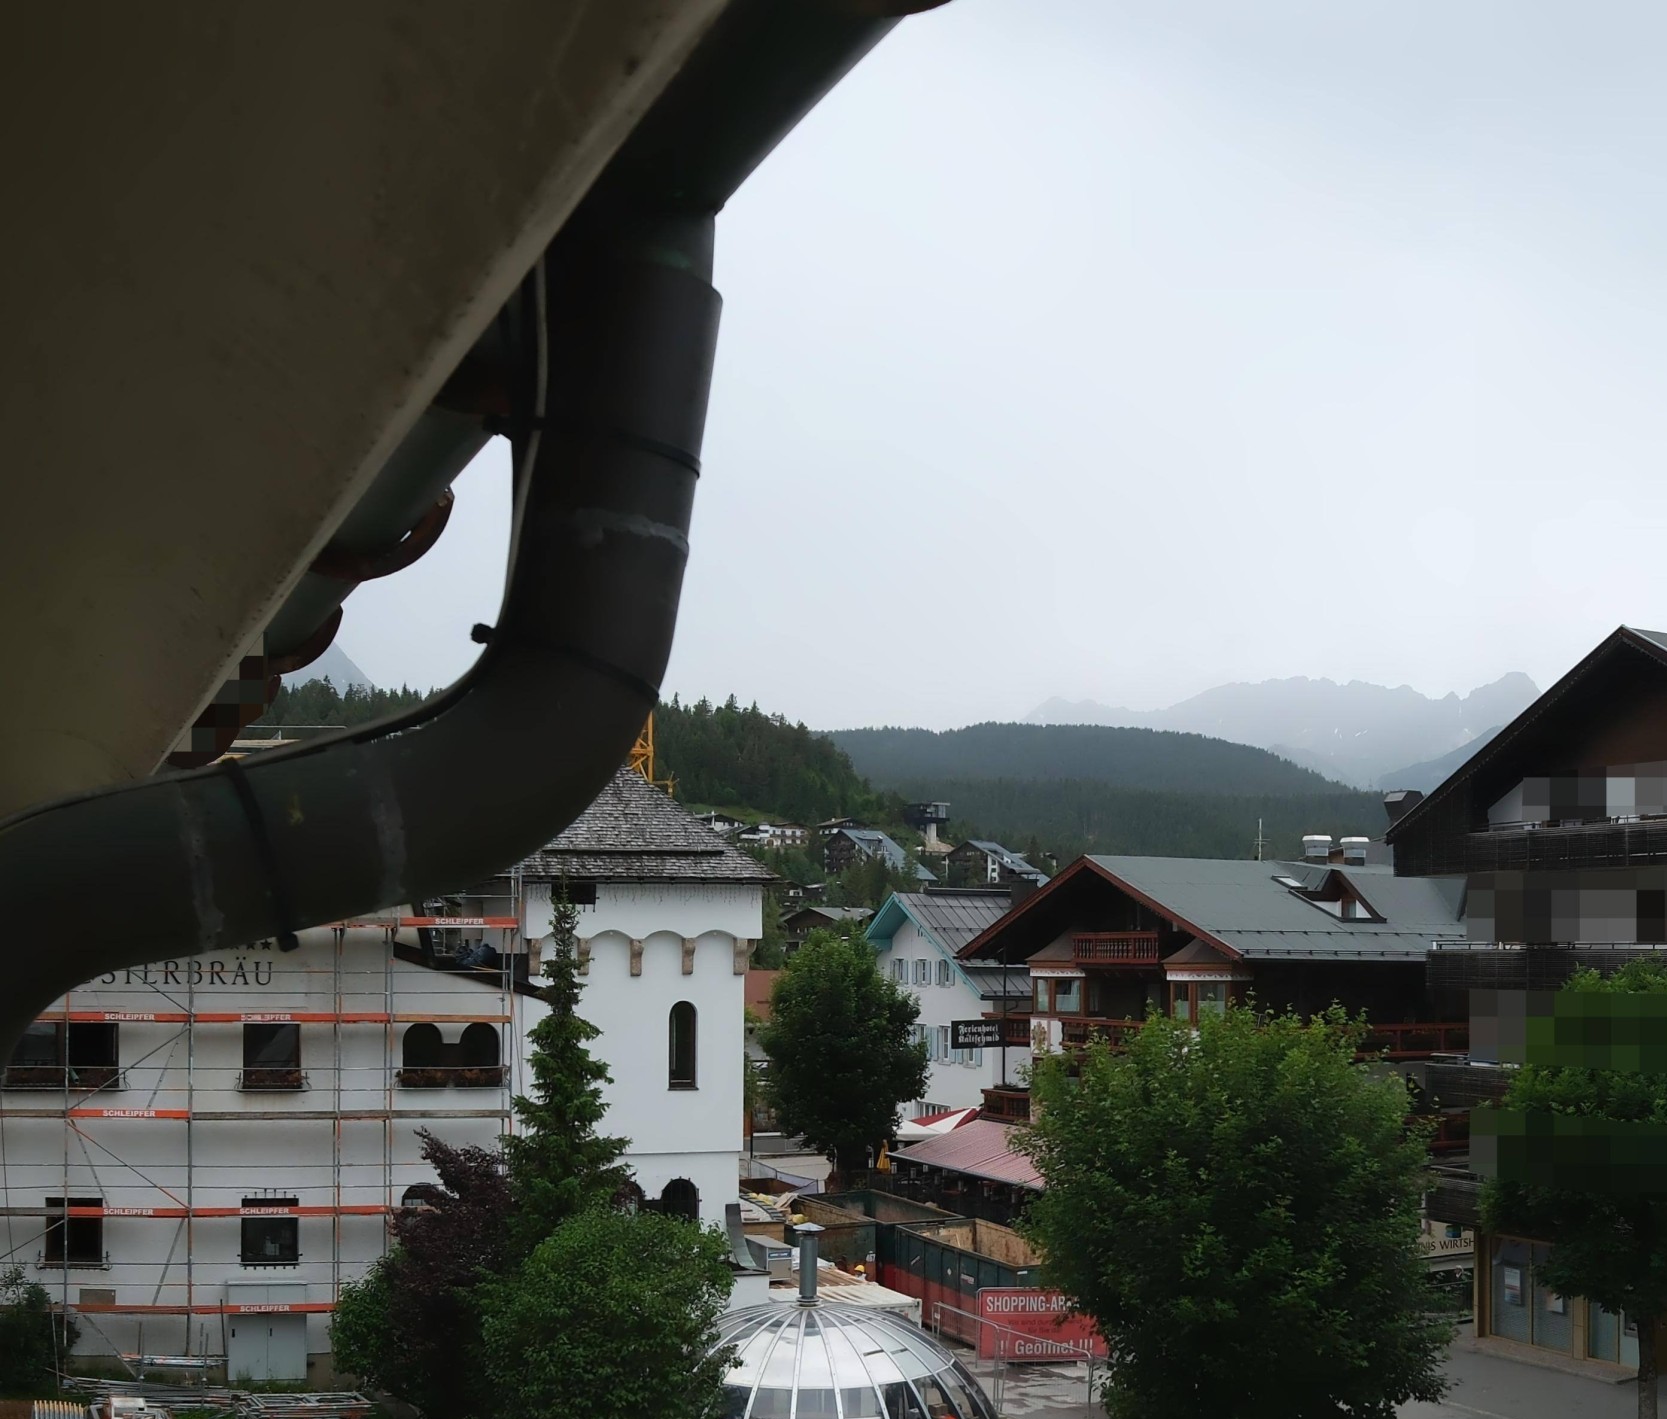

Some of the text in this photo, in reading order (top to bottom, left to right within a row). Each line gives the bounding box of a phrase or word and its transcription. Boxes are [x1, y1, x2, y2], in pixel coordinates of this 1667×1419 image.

[435, 917, 485, 926] SCHLEIPFER
[84, 957, 273, 986] STERBRÄU
[103, 1012, 155, 1021] SCHLEIPFER
[102, 1108, 155, 1118] SCHLEIPFER
[102, 1207, 154, 1217] SCHLEIPFER
[240, 1206, 290, 1216] SCHLEIPFER
[240, 1303, 291, 1313] SCHLEIPFER
[986, 1295, 1080, 1312] SHOPPING-AR
